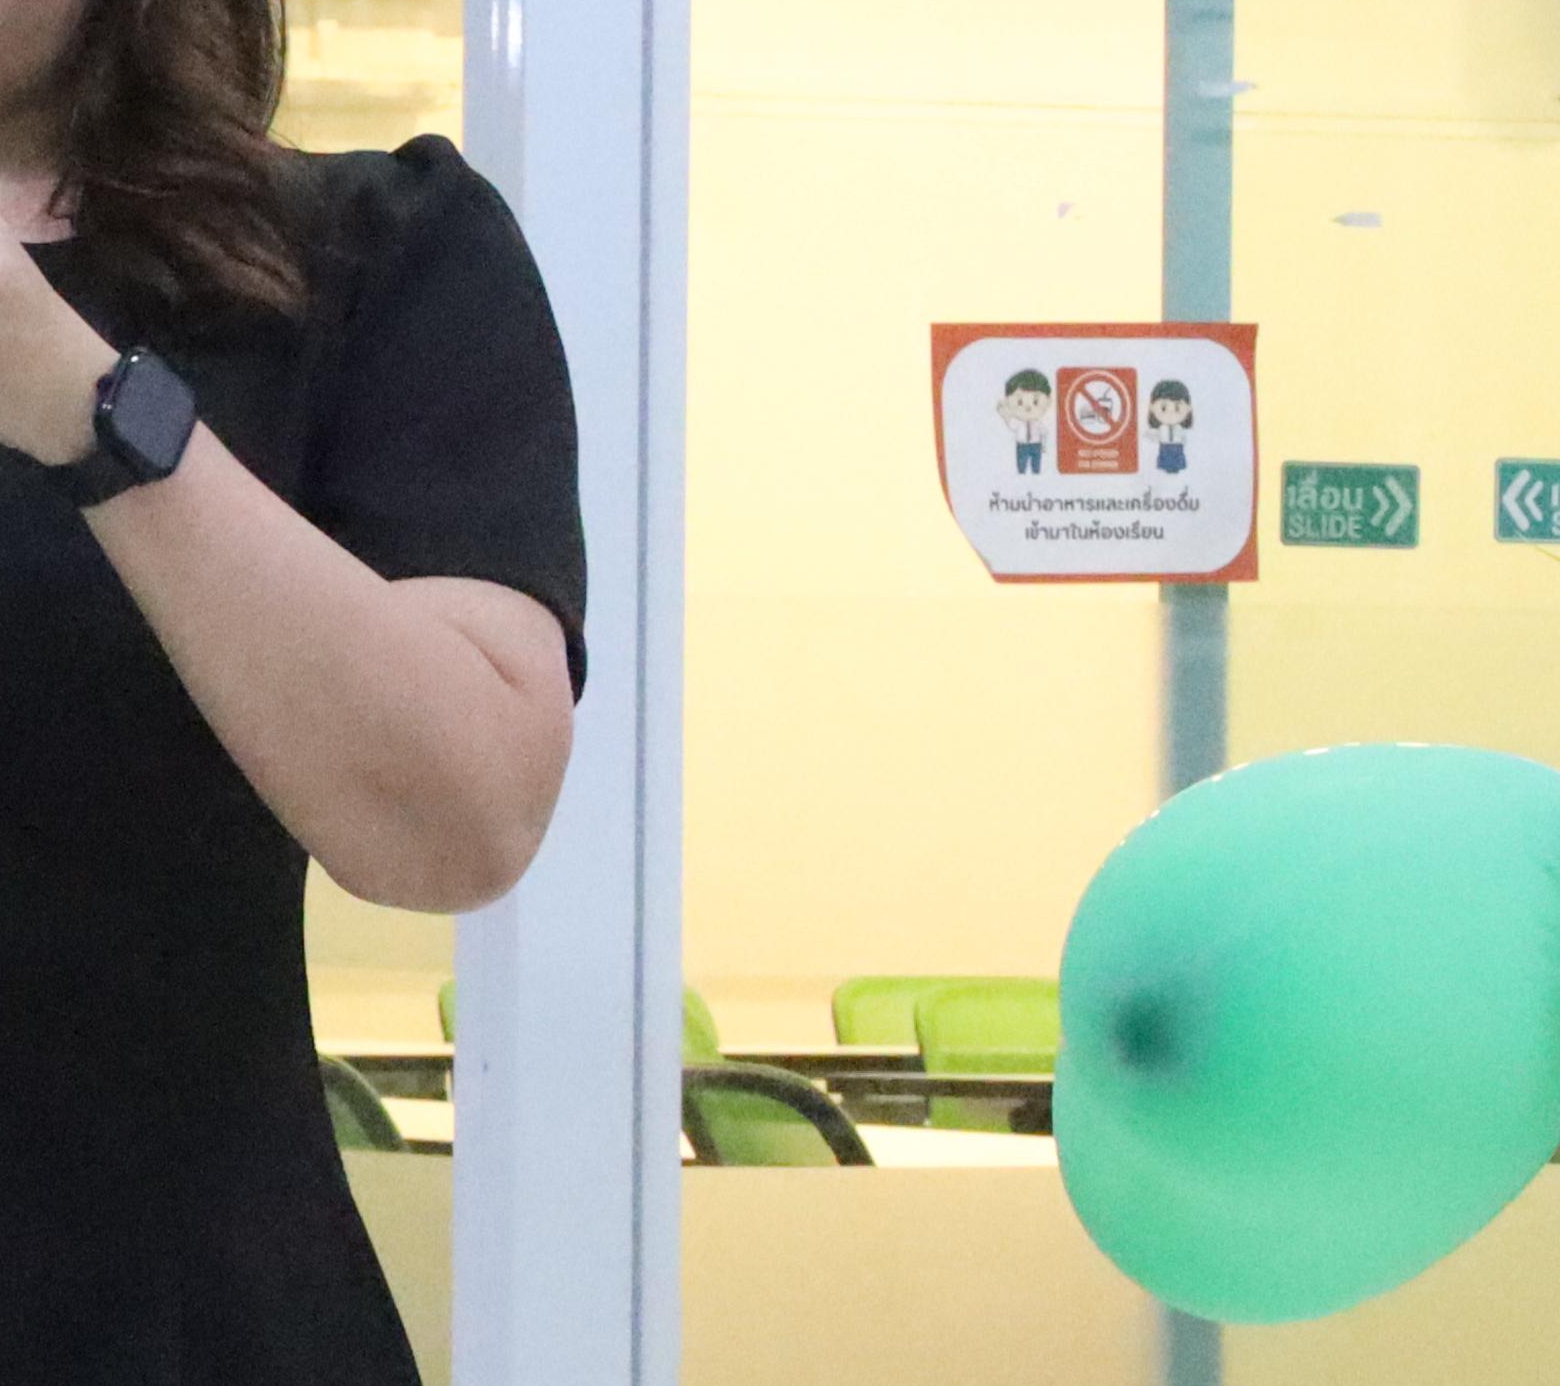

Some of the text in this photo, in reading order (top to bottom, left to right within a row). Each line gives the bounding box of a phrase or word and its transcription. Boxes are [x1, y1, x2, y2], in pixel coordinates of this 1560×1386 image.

[989, 485, 1200, 512] ห้ามนำอาหารและเครื่องดื่ม
[1287, 469, 1364, 510] เลื่อน
[1025, 520, 1164, 541] เข้ามาในห้องเรียน
[1288, 513, 1363, 539] SLIDE
